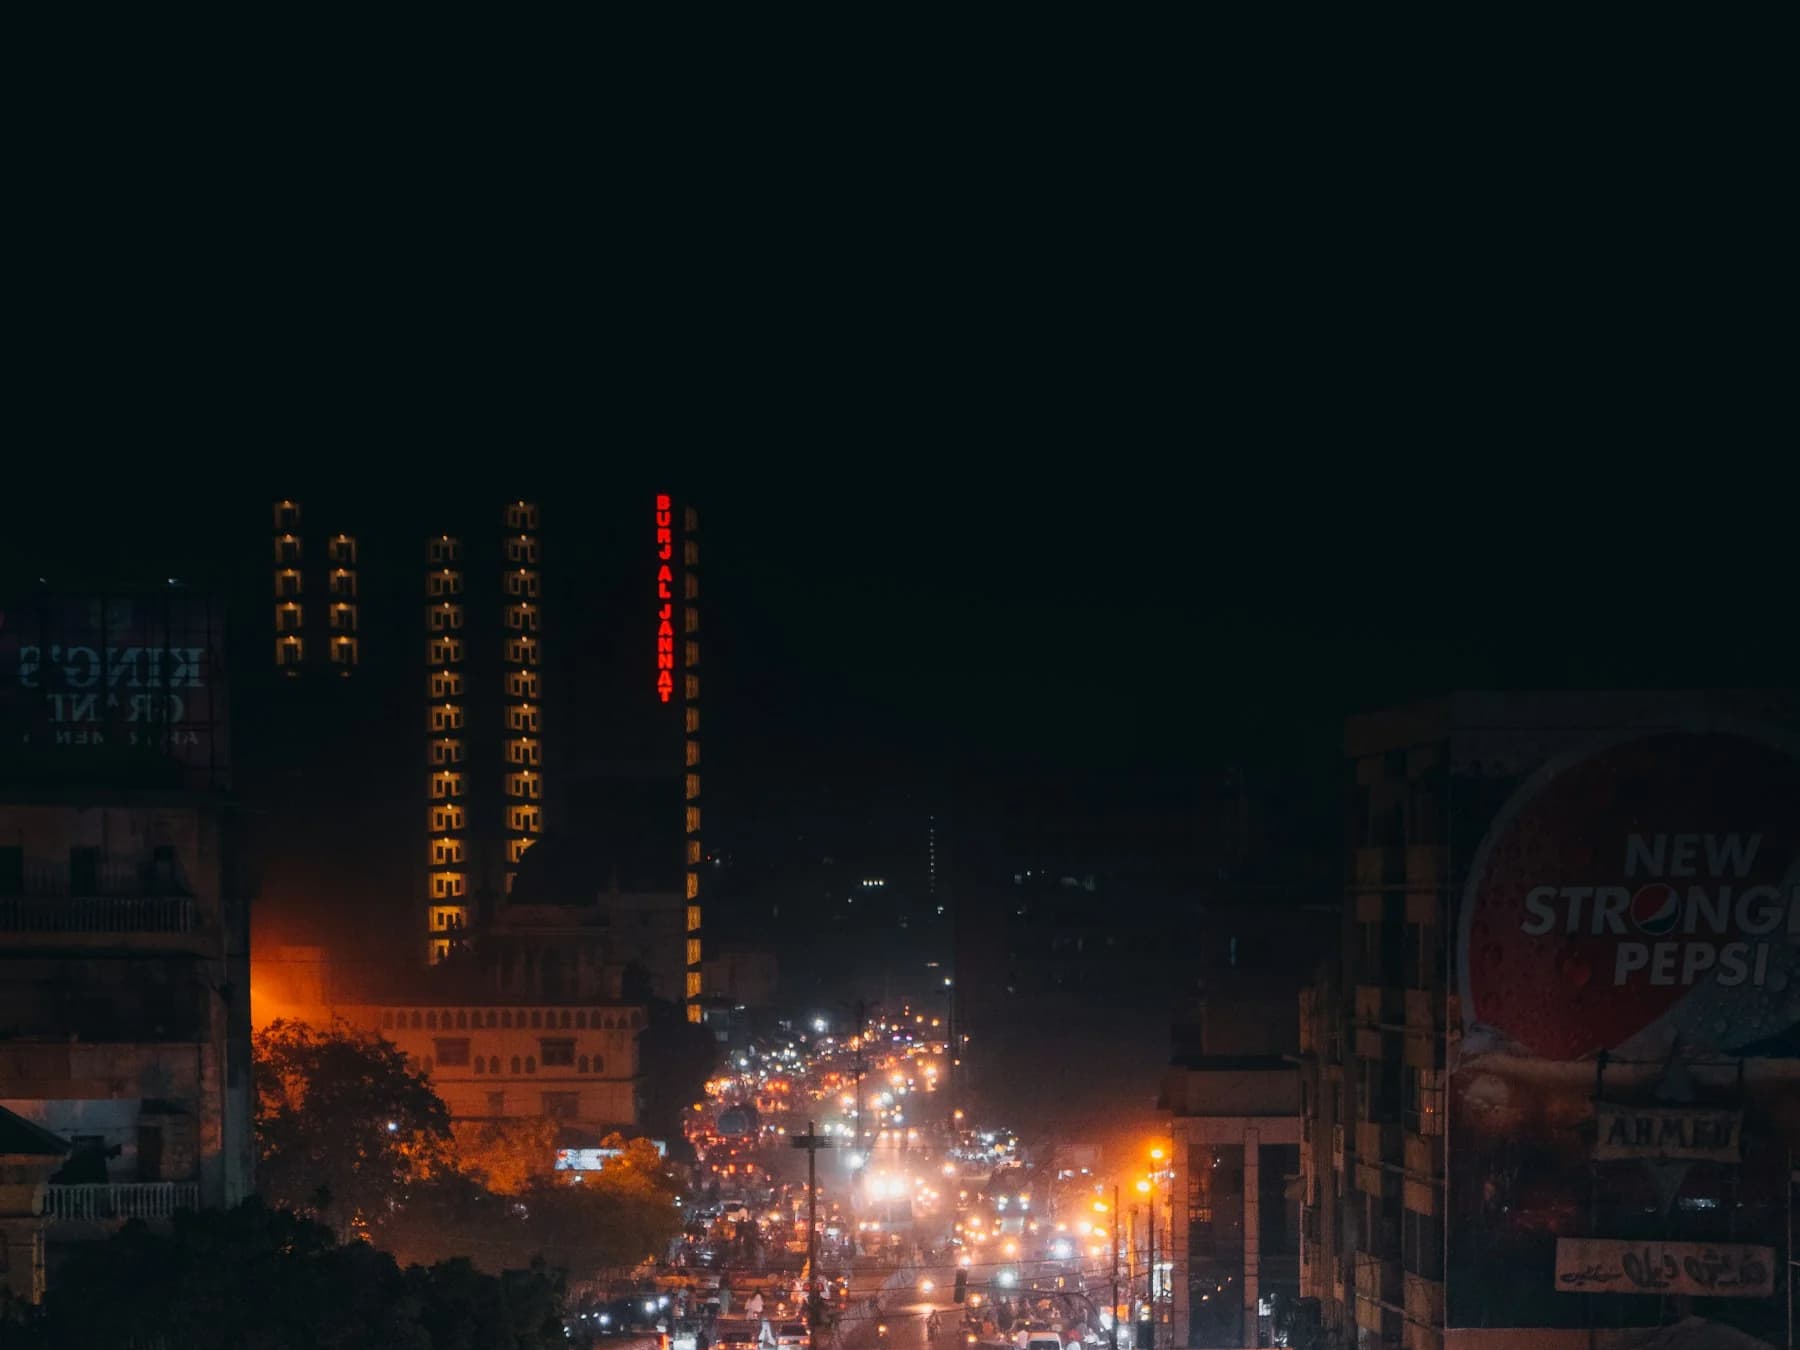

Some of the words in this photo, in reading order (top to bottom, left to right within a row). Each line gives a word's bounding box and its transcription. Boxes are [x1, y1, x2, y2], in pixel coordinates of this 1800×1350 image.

[657, 495, 672, 560] BURJ
[658, 565, 673, 598] AL
[658, 604, 674, 702] JANNAT
[1624, 833, 1764, 878] NEW
[1613, 942, 1769, 986] PEPSI
